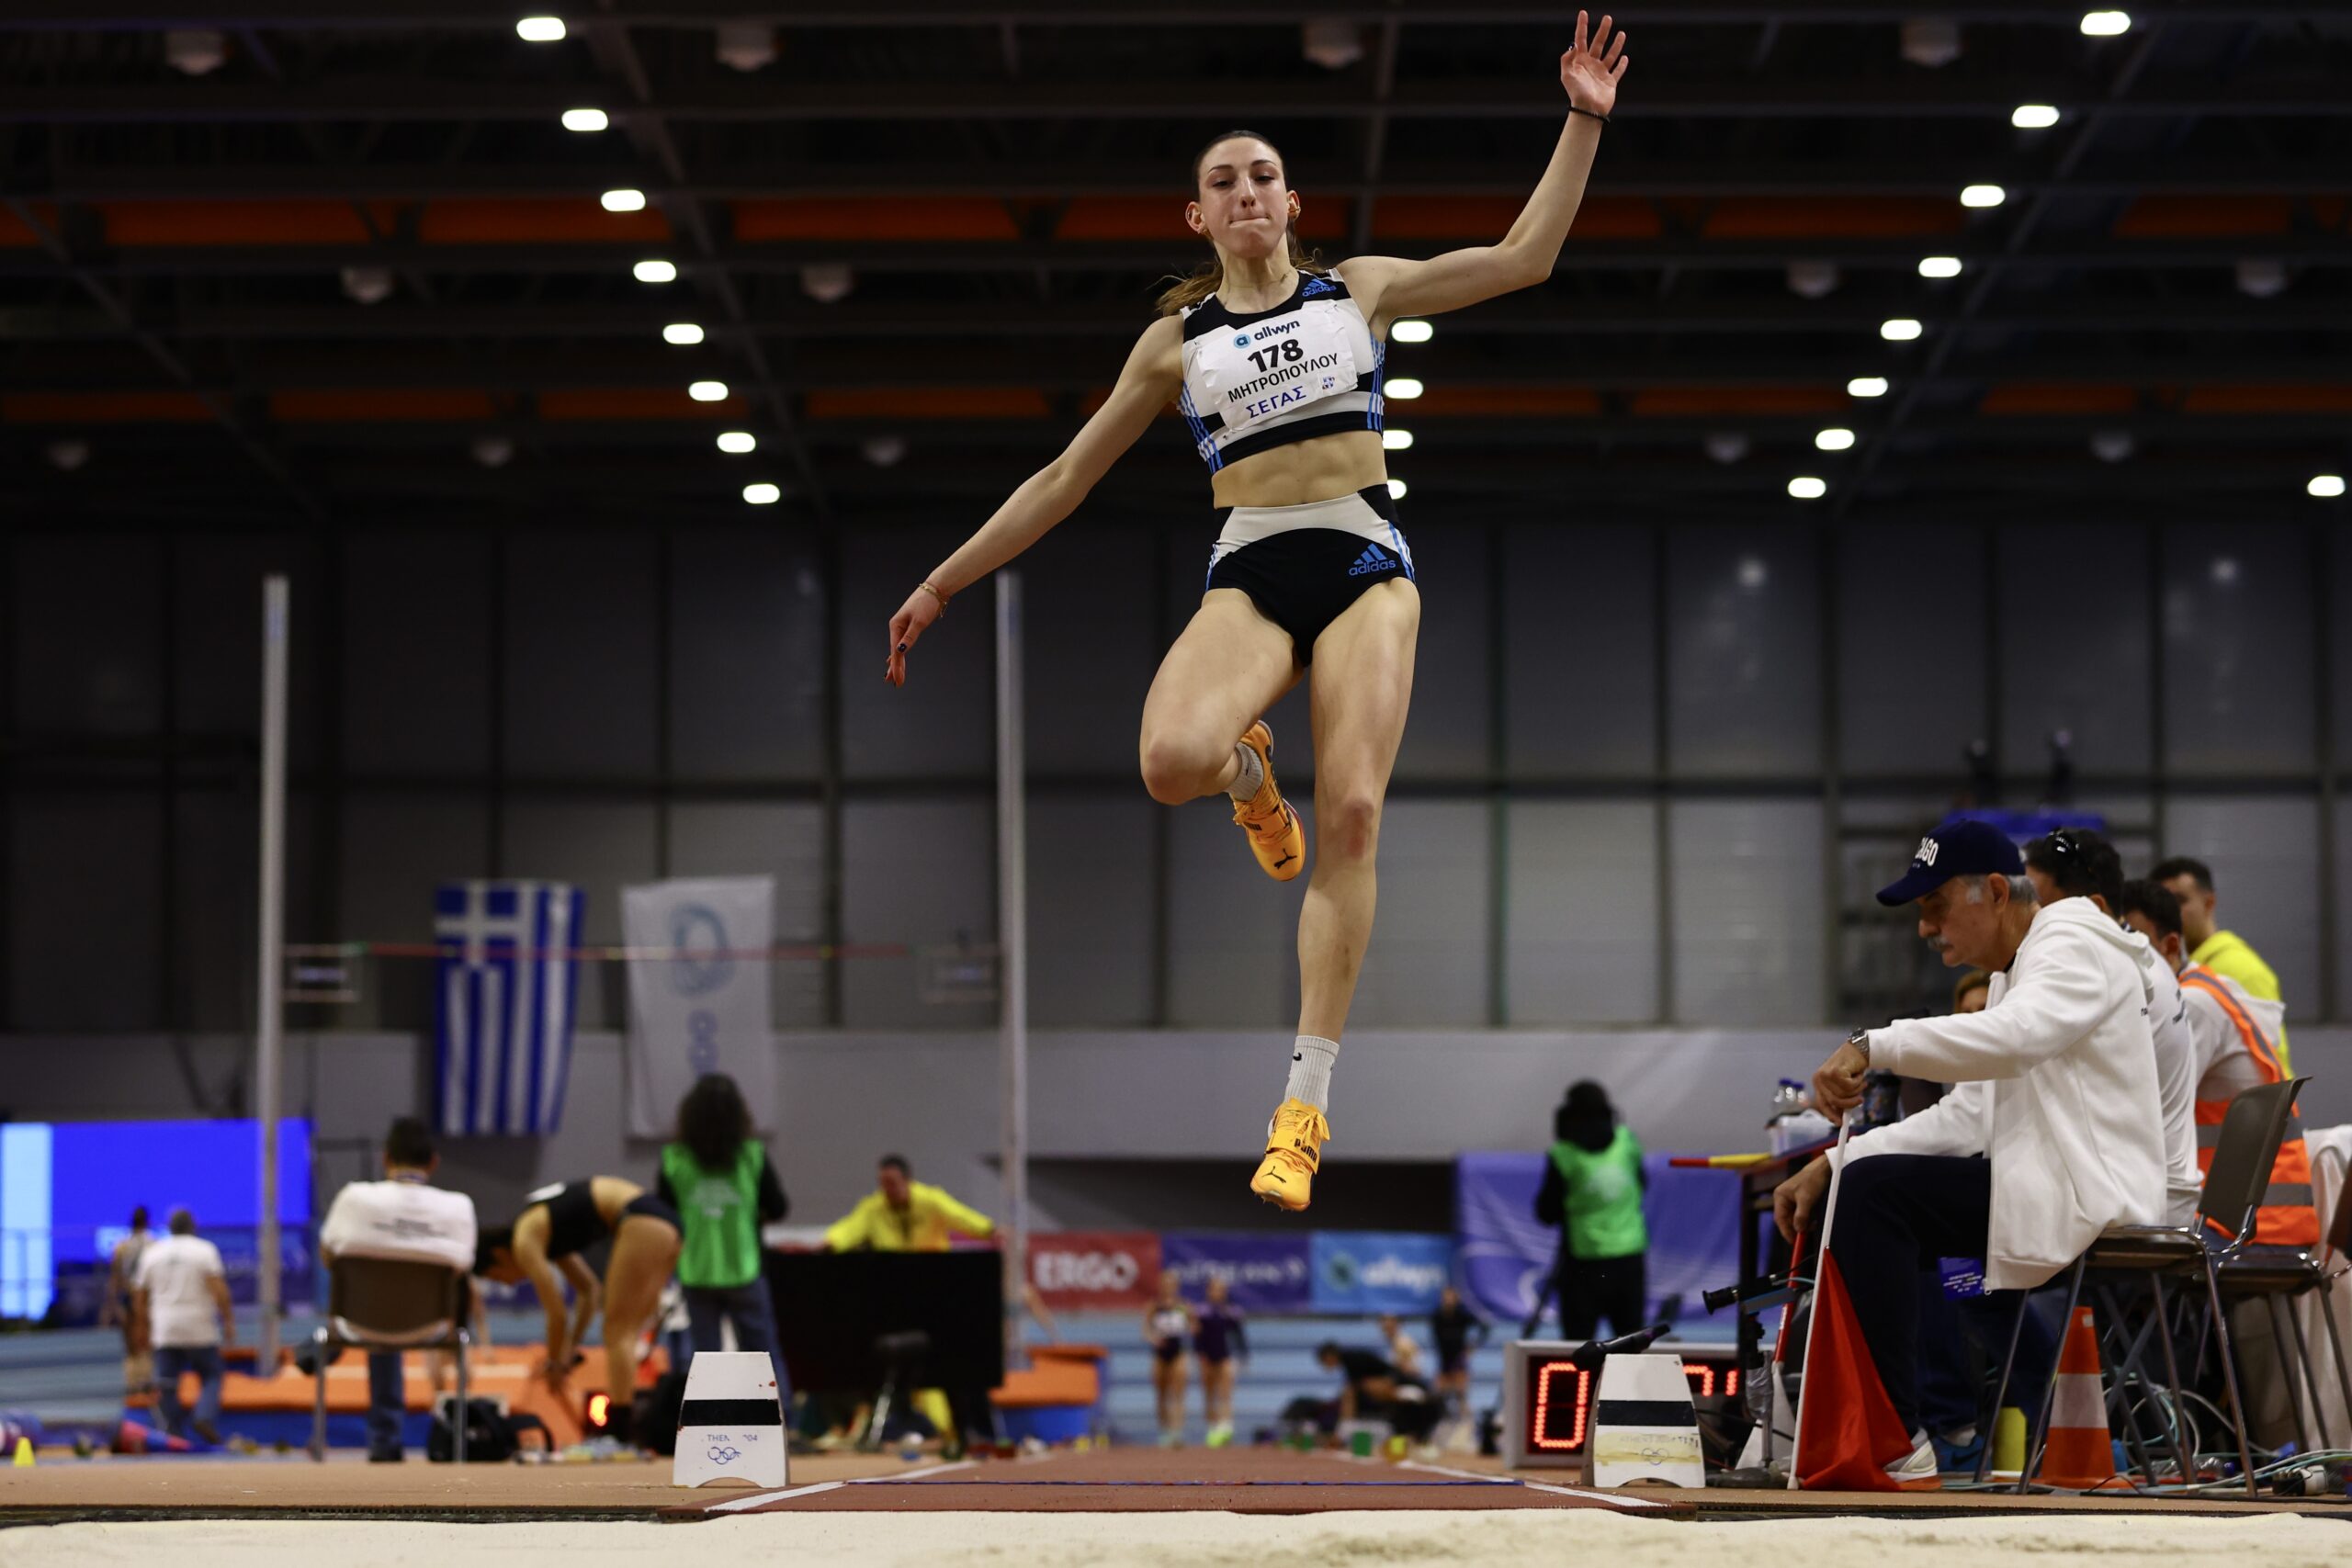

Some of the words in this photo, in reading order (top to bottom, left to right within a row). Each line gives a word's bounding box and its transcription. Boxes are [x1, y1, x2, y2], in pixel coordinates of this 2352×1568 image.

[1302, 283, 1337, 298] adidas
[1254, 319, 1300, 341] allwyn
[1247, 338, 1304, 373] 178
[1227, 353, 1339, 403] ΜΗΤΡΟΠΟΥΛΟΥ
[1246, 386, 1307, 419] ΣΕΓΑΣ
[1348, 558, 1396, 577] adidas
[1033, 1251, 1139, 1292] ERGO
